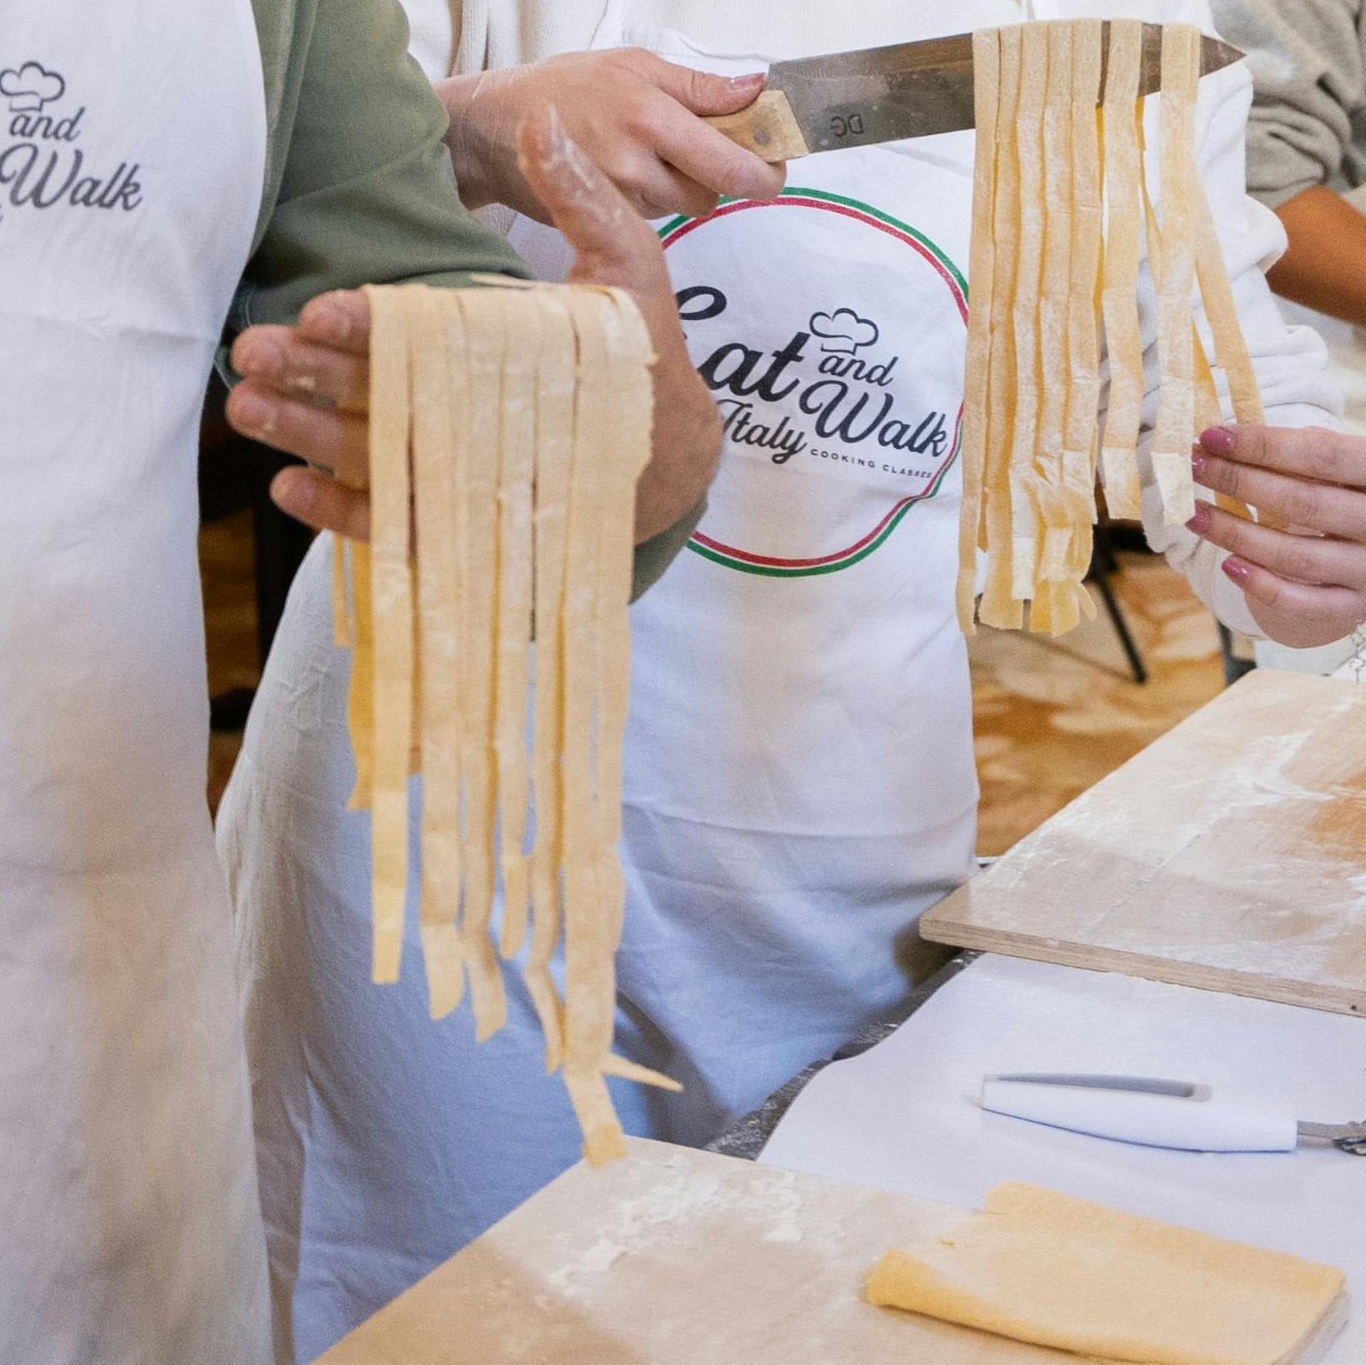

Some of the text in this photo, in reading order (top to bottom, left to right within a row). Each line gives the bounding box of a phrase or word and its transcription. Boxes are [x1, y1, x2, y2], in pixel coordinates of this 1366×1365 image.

[9, 107, 86, 142] and
[818, 355, 899, 386] and
[799, 380, 948, 457] Walk
[810, 448, 933, 479] COOKING CLASSES
